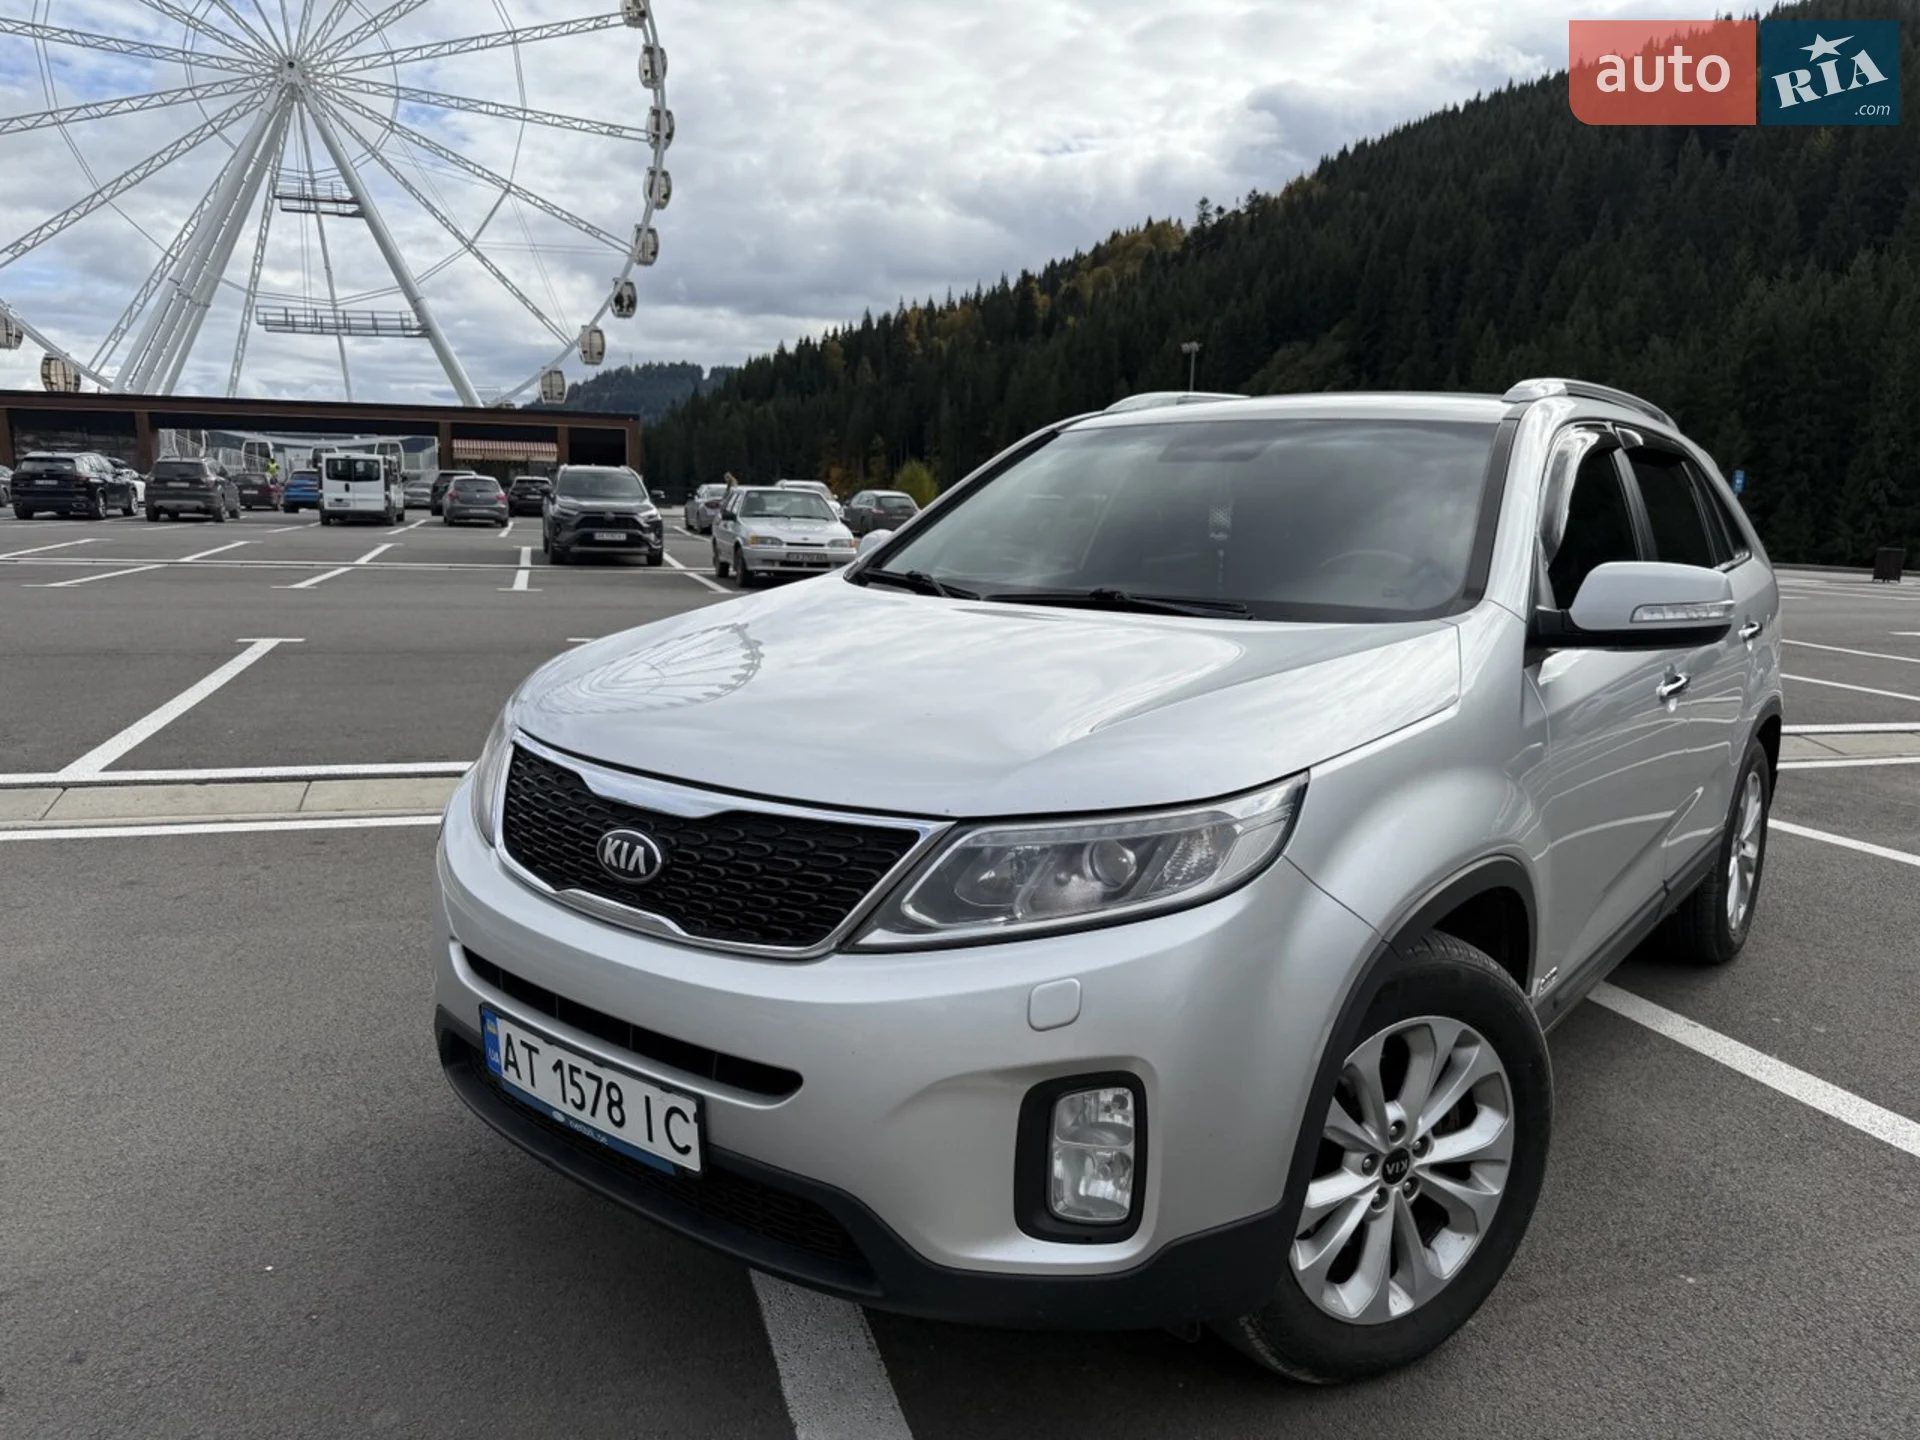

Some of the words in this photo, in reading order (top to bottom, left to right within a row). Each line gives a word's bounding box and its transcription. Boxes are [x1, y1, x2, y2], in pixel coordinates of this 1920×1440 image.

[603, 836, 646, 875] KIA
[504, 1032, 540, 1087] AT
[552, 1058, 626, 1128] 1578
[644, 1094, 692, 1155] IC
